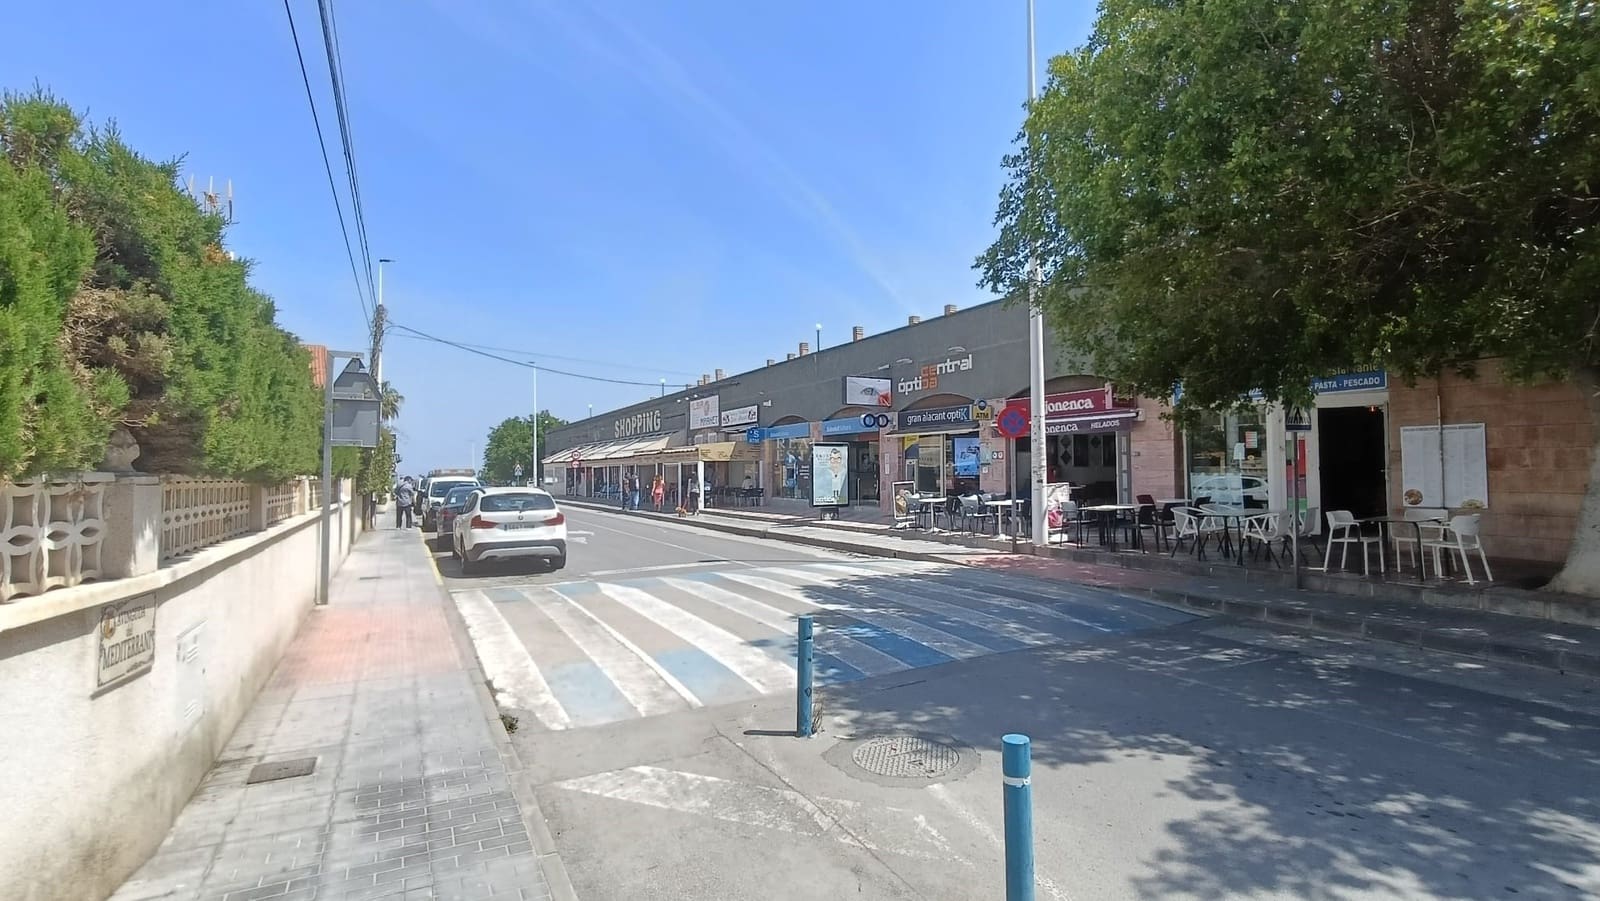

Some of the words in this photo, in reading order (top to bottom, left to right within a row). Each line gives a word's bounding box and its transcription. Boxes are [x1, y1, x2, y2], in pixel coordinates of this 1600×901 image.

[921, 354, 973, 376] central
[1314, 381, 1338, 390] PASTA
[1343, 376, 1381, 388] PESCADO
[1045, 398, 1094, 414] jonenca
[614, 410, 661, 438] SHOPPING
[907, 415, 921, 425] gran
[923, 411, 945, 422] alacant
[1045, 423, 1079, 434] onenca
[1091, 420, 1120, 429] HELADOS
